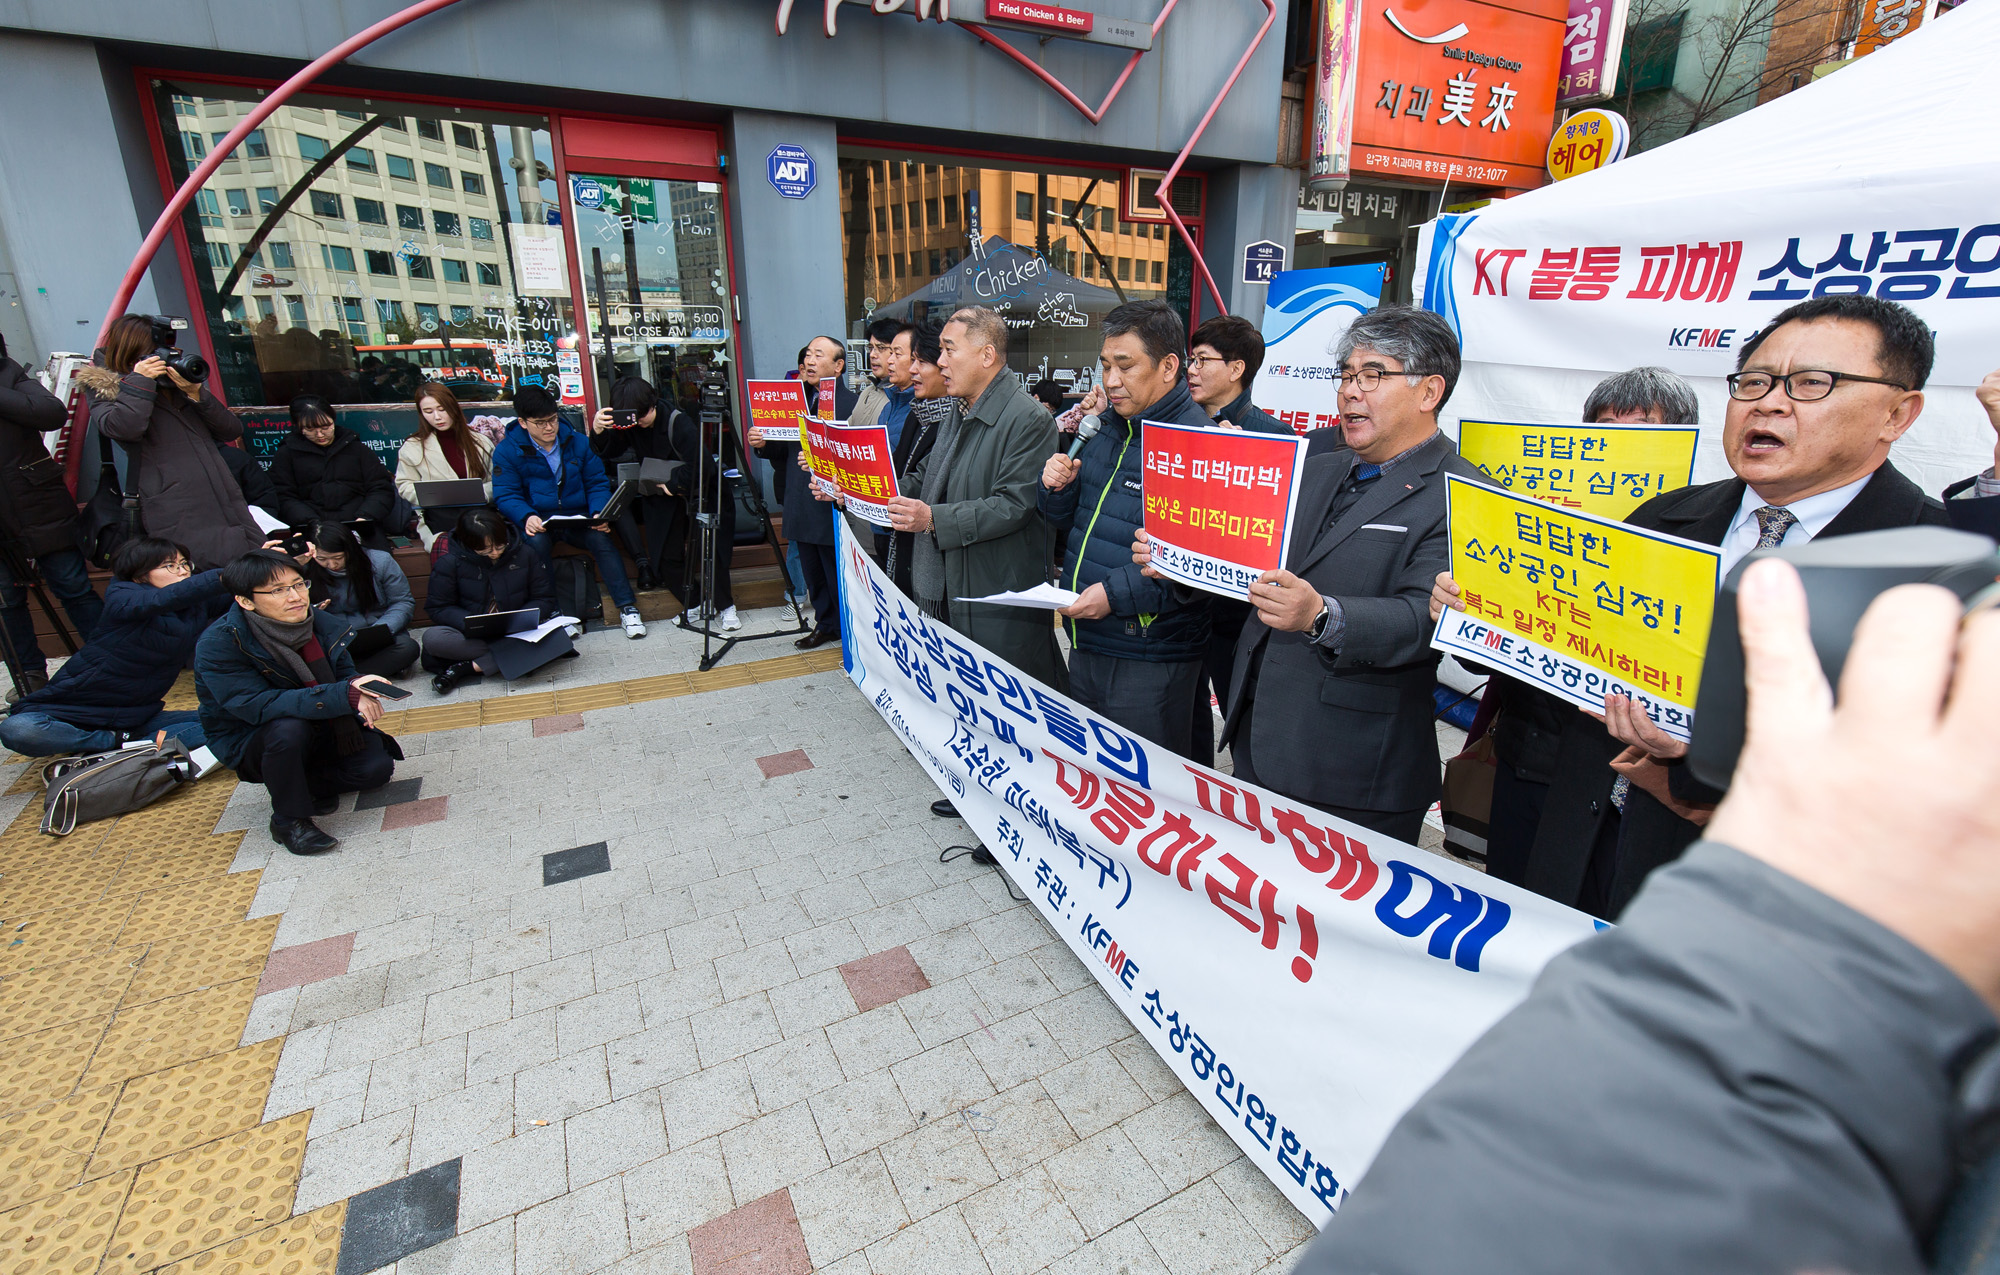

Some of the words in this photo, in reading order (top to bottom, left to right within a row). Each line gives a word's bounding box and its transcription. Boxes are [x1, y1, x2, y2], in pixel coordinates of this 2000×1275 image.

[998, 3, 1020, 15] Fried
[1023, 7, 1055, 21] Chicken
[1057, 13, 1064, 22] &
[1066, 14, 1085, 26] Beer
[1443, 45, 1467, 60] Smile
[1467, 50, 1496, 67] Design
[1497, 56, 1523, 72] Group
[1377, 79, 1433, 122] 치과
[1565, 119, 1601, 140] 황제영
[1366, 153, 1390, 167] 압구정
[1392, 157, 1422, 171] 치과미래
[1424, 160, 1447, 173] 충정로
[1466, 165, 1508, 181] 312-1077
[1553, 138, 1604, 174] 헤어
[775, 162, 808, 182] ADT
[580, 189, 600, 200] ADT
[932, 275, 957, 294] MENU
[975, 256, 1047, 297] Chicken
[1256, 263, 1271, 279] 14
[1473, 248, 1527, 296] KT
[1529, 247, 1621, 300] 불통
[1626, 240, 1743, 303] 피해
[483, 313, 561, 332] TAKE-OUT
[622, 312, 660, 322] OPEN
[668, 312, 685, 323] PM
[694, 312, 718, 323] 5:00
[623, 326, 661, 337] CLOSE
[668, 326, 687, 337] AM
[695, 327, 720, 337] 2:00
[1668, 327, 1736, 348] KFME
[1268, 365, 1291, 376] KFME
[753, 391, 781, 402] 소상공인
[782, 391, 799, 402] 피해
[1522, 434, 1608, 462] 답답한
[1146, 451, 1185, 479] 요금은
[1192, 459, 1282, 496] 따박따박
[1587, 470, 1664, 498] 심정!
[1146, 494, 1183, 525] 보상은
[1189, 506, 1275, 547] 미적미적
[1515, 511, 1612, 569] 답답한
[1465, 538, 1579, 598] 소상공인
[1593, 580, 1682, 635] 심정!
[1536, 590, 1592, 630] KT는
[1457, 620, 1514, 655] KFME
[1465, 589, 1504, 620] 복구
[1513, 609, 1556, 643] 일정
[1566, 631, 1683, 697] 제시하라!
[850, 540, 890, 618] KT는
[897, 598, 1152, 791] 소상공인들의
[1182, 763, 1511, 973] 피해에
[873, 605, 937, 704] 진정성
[1040, 746, 1319, 983] 대응하라!
[943, 717, 1010, 795] (조속한
[1003, 781, 1132, 910] 피해복구)
[1080, 912, 1140, 991] KFME
